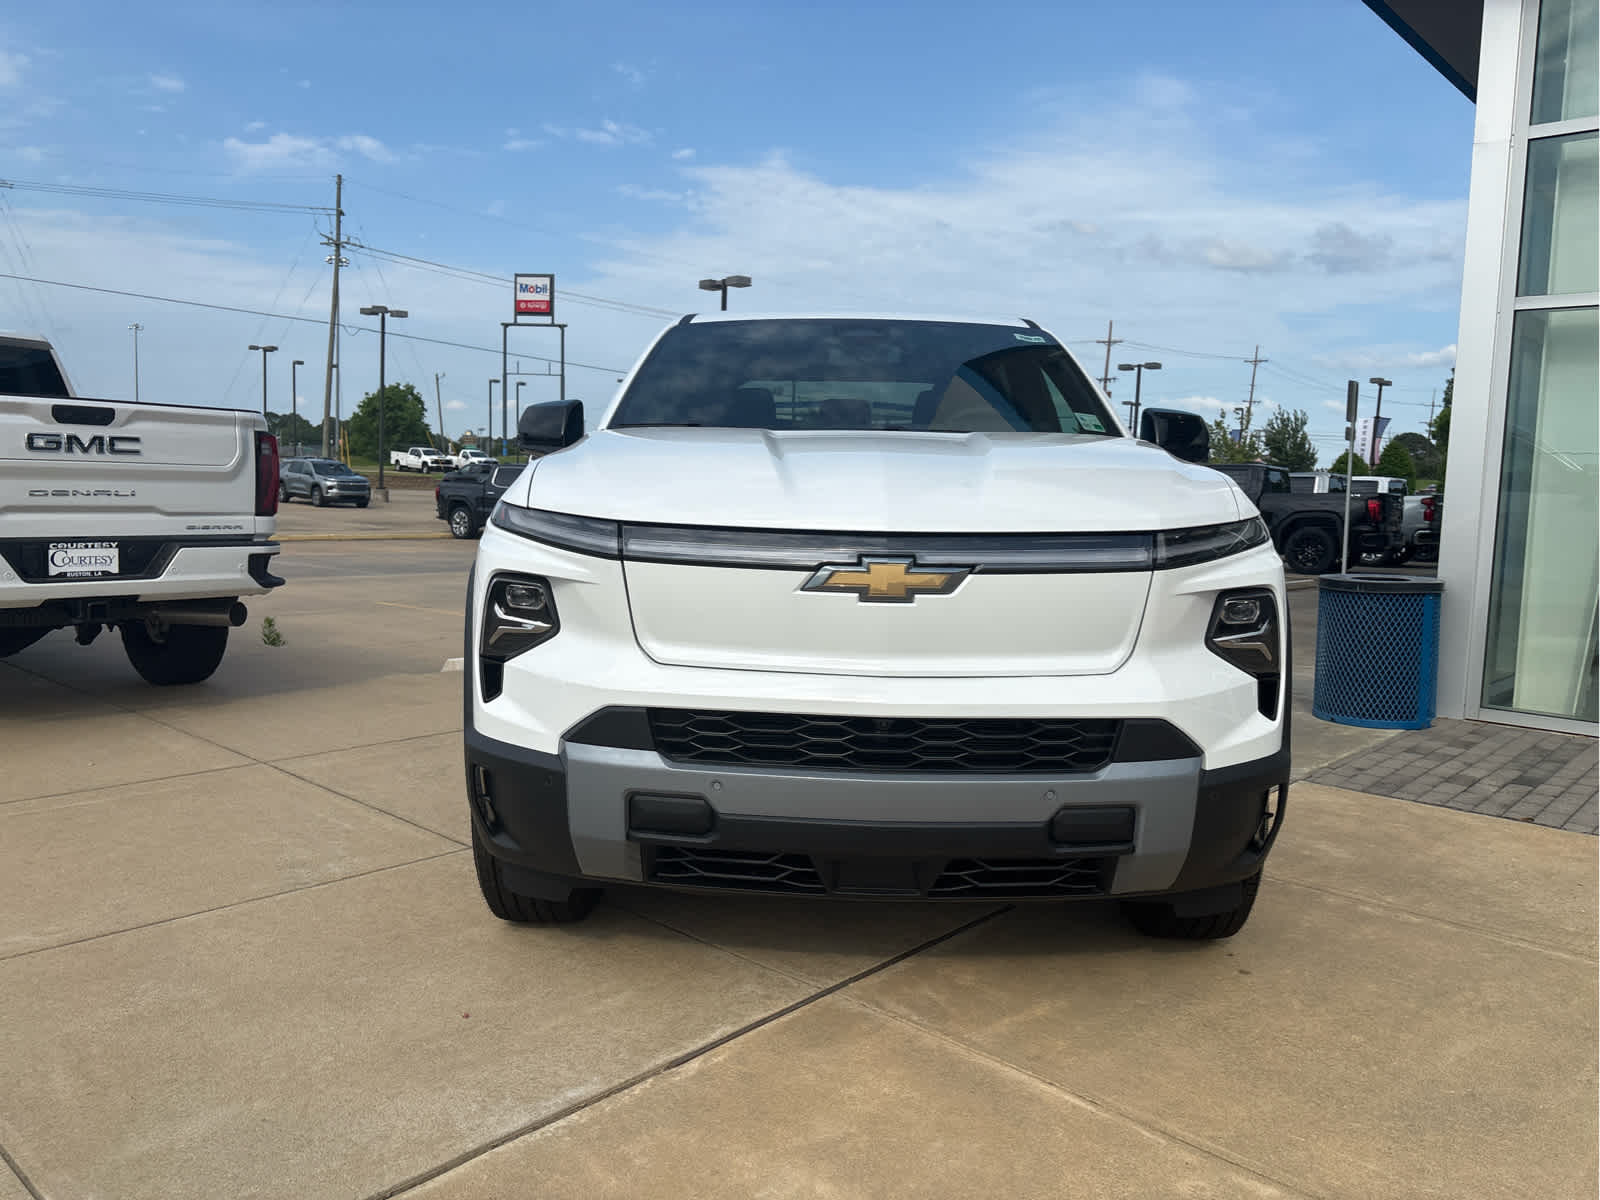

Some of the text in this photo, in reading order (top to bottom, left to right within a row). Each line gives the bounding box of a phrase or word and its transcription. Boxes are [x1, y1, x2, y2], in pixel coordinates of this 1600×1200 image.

[519, 283, 548, 294] Mobil
[24, 432, 142, 455] GMC
[28, 489, 136, 497] DENALI
[48, 541, 119, 549] COURTESY
